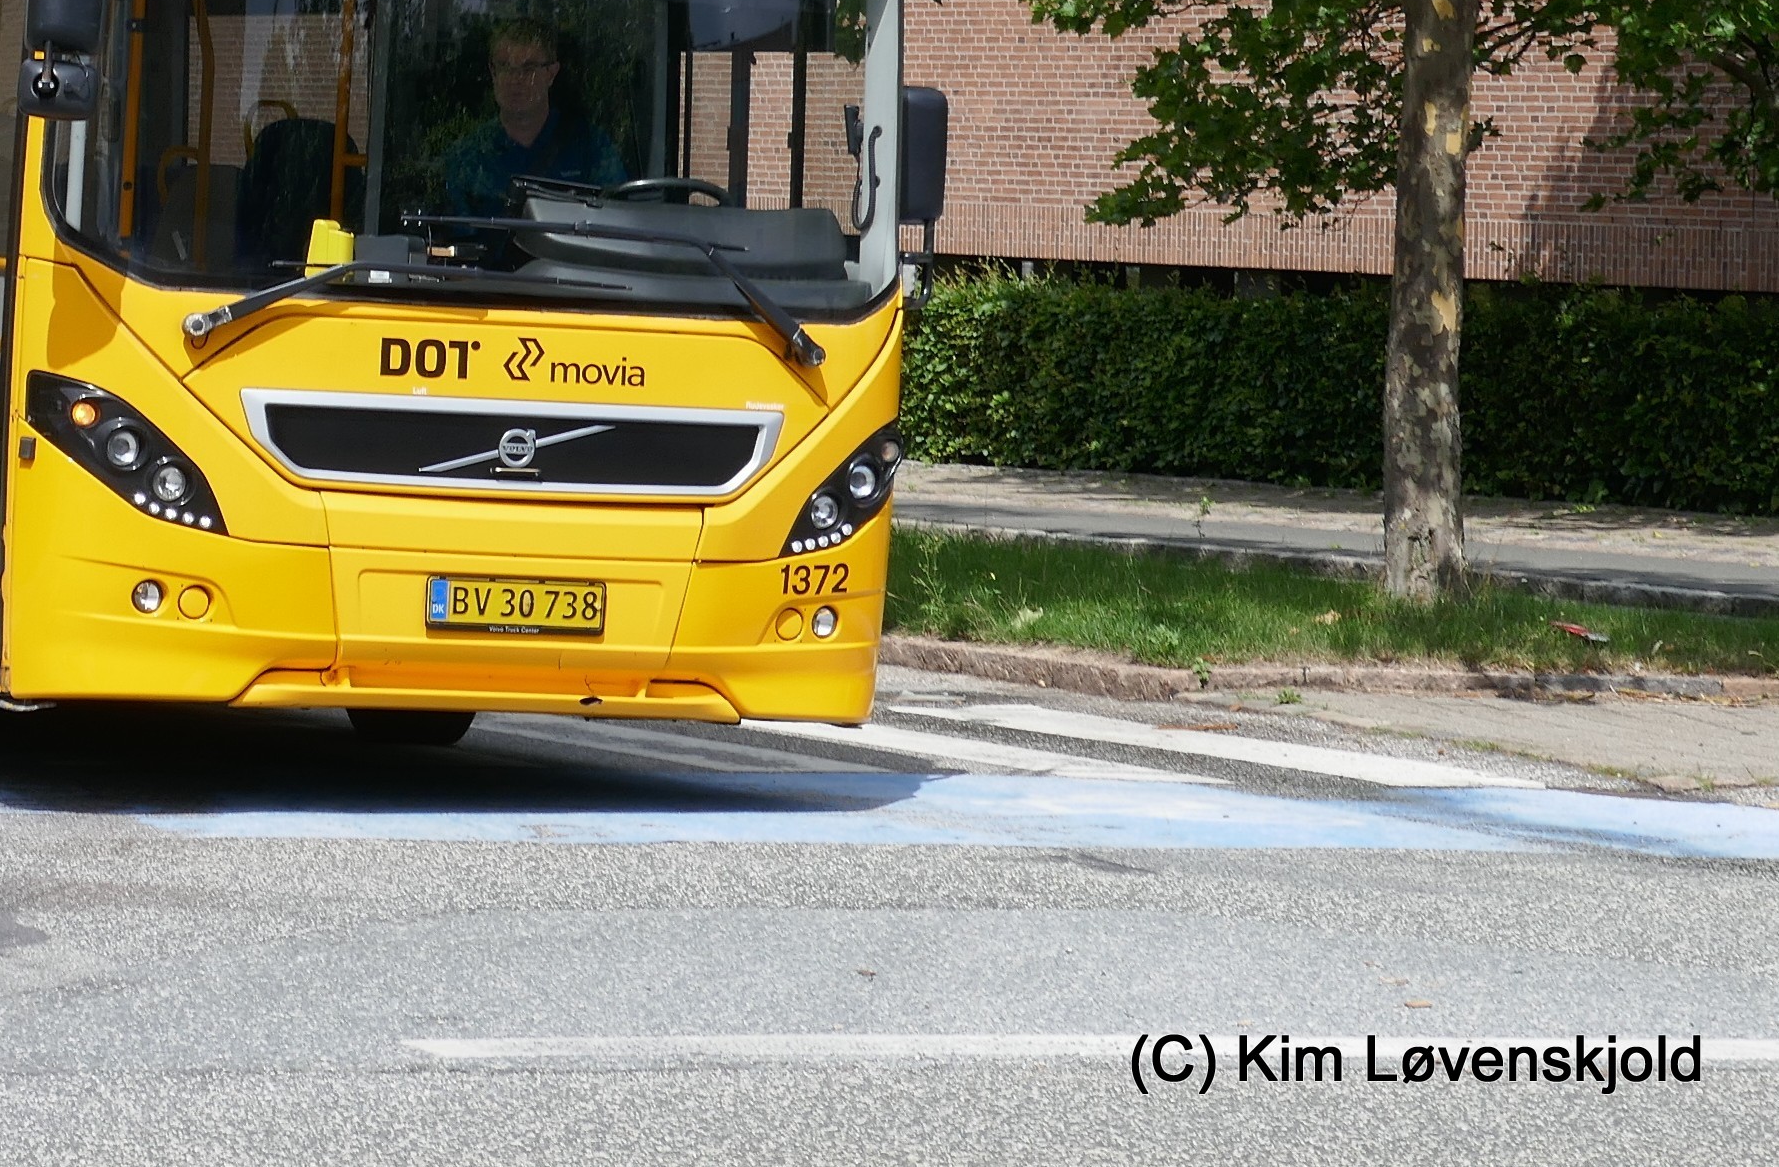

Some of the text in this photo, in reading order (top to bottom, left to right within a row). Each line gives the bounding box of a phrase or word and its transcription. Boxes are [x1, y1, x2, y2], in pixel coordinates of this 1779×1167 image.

[379, 337, 646, 387] DOT movia
[502, 444, 534, 454] VOLVO
[781, 563, 850, 595] 1372
[432, 603, 445, 615] DK
[452, 586, 599, 621] BV 30 738
